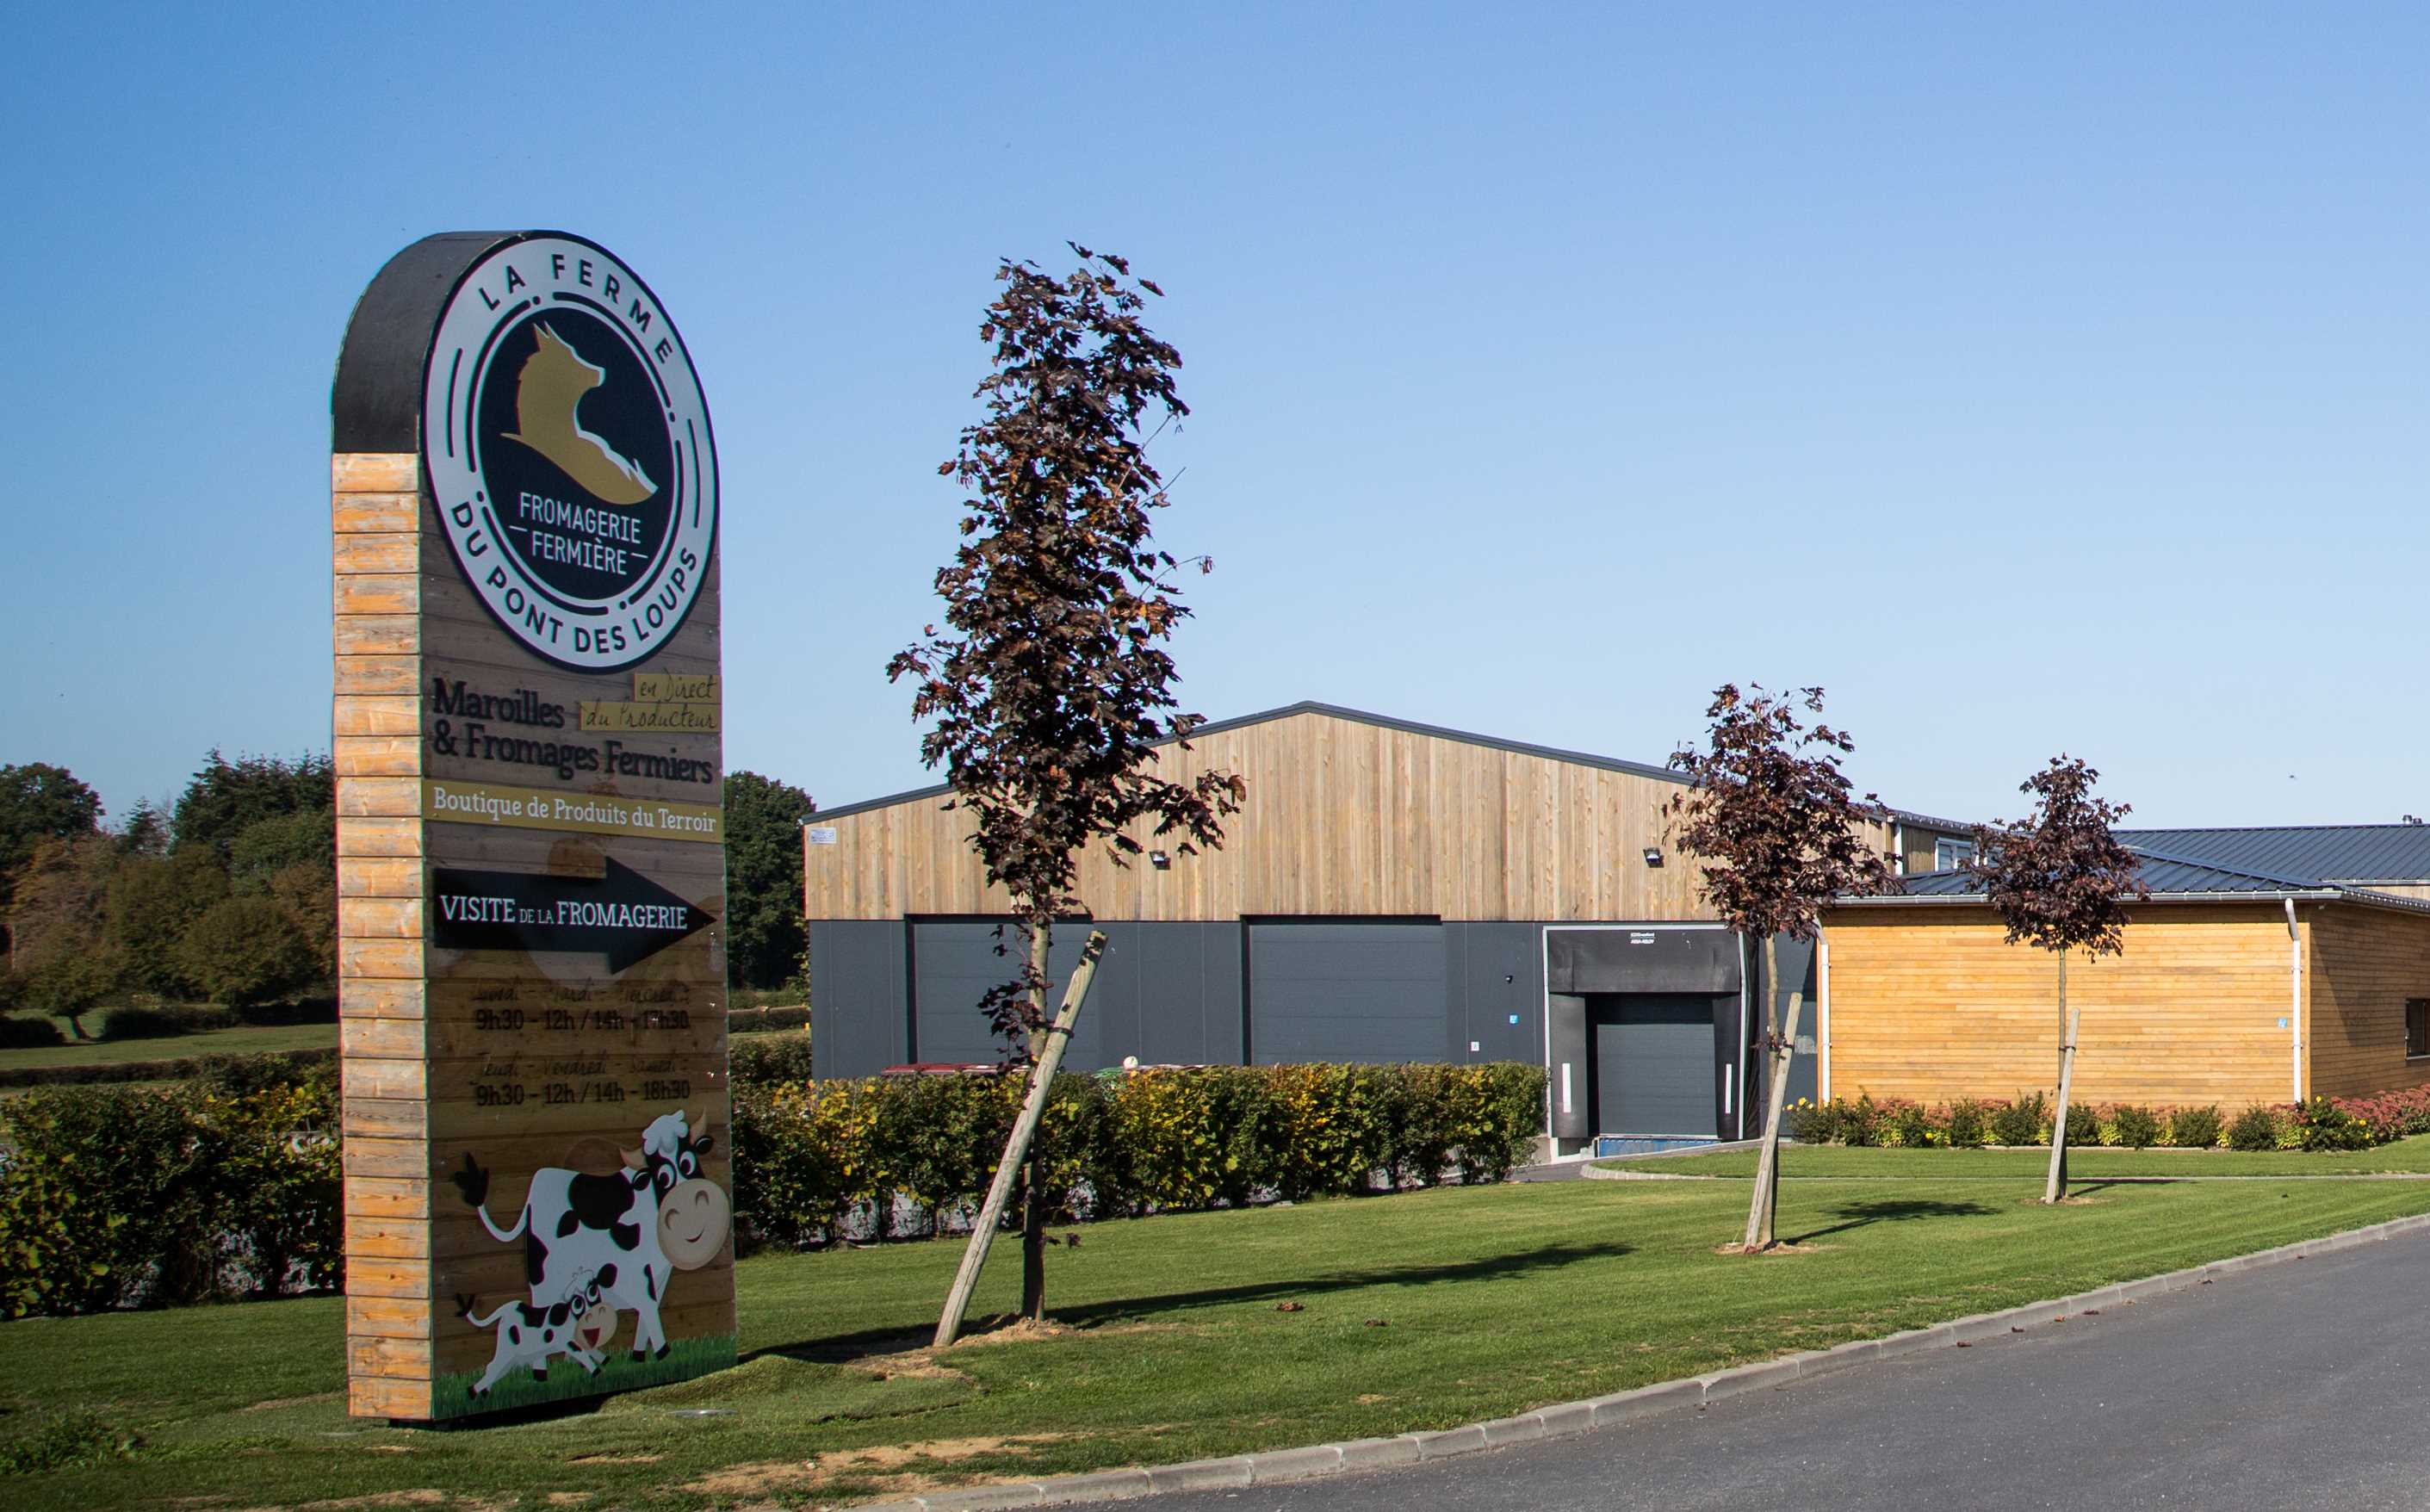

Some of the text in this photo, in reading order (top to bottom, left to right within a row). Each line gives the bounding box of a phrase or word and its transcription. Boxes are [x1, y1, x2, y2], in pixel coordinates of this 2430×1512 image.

[479, 253, 673, 364] LA FERME
[519, 491, 642, 545] FROMAGERIE
[531, 530, 628, 576] FERMIÈRE
[451, 500, 697, 655] DU PONT DES LOUPS
[432, 677, 566, 729] Maroilles
[586, 697, 611, 726] du
[432, 718, 713, 784] & Fromages Fermiers
[434, 786, 716, 833] Boutique de Produits du Terroir
[439, 895, 688, 930] VISITE DE LA FROMAGERIE
[475, 1008, 524, 1030] 9h30
[544, 1009, 575, 1030] 12h
[594, 1010, 624, 1029] 14h
[475, 1084, 524, 1106] 9h30
[544, 1083, 575, 1104] 12h
[594, 1082, 624, 1103] 14h
[642, 1080, 690, 1100] 18h30
